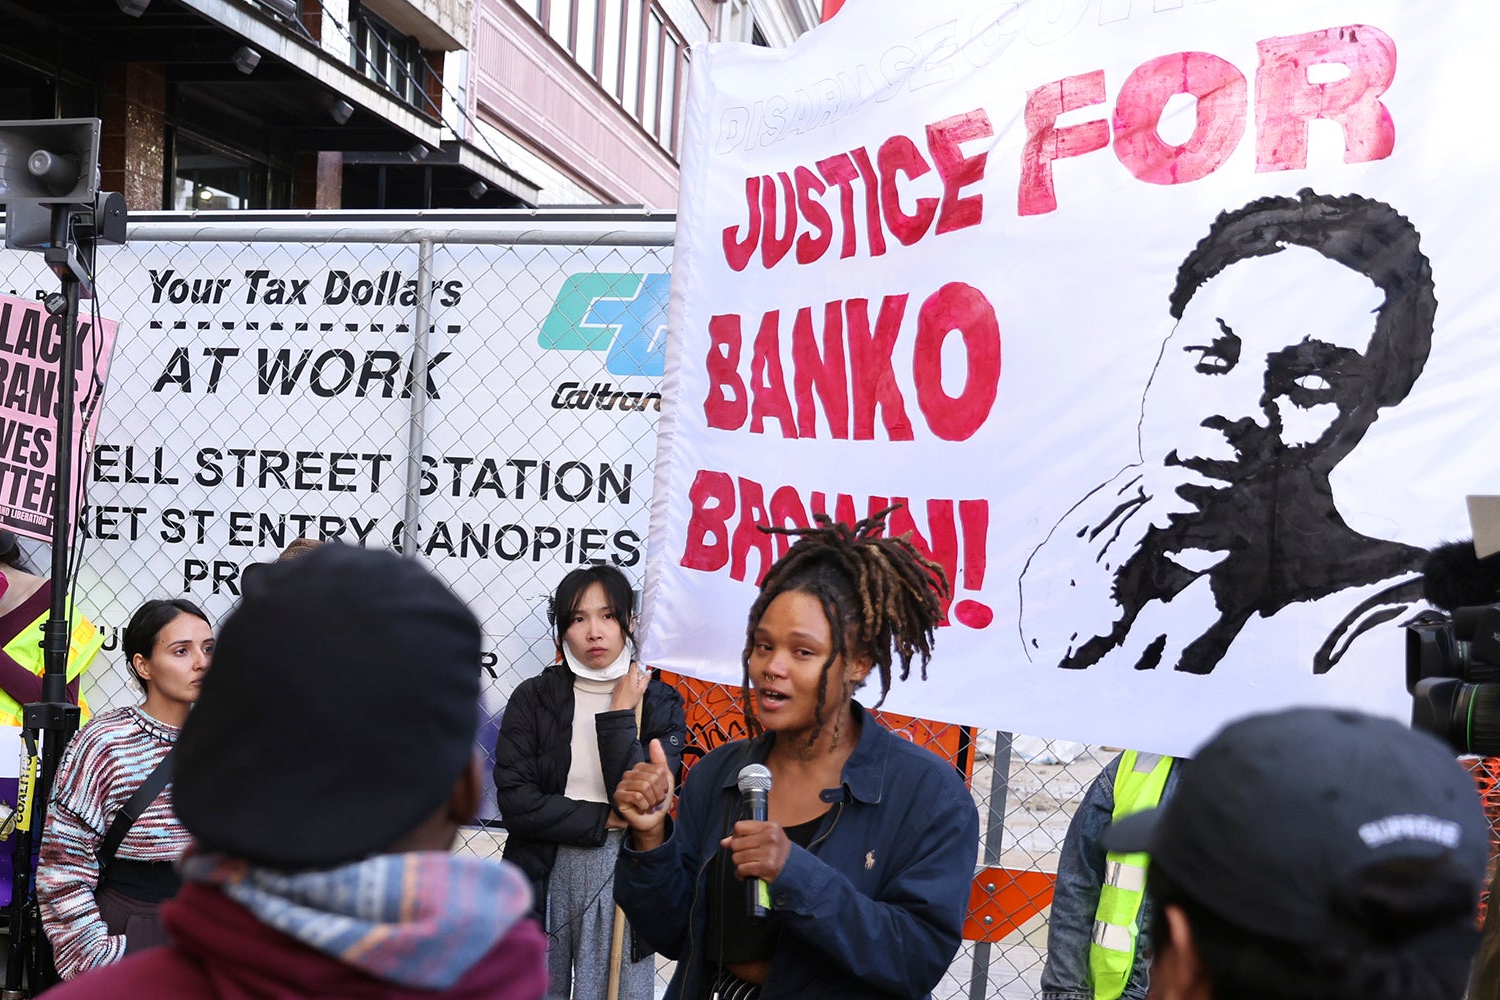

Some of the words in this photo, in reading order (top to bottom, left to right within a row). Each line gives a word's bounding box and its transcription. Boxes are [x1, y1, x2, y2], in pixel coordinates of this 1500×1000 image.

[1017, 24, 1396, 216] FOR
[722, 107, 995, 272] JUSTICE
[149, 269, 231, 306] Your
[242, 269, 308, 306] Tax
[324, 269, 463, 308] Dollars
[152, 347, 239, 394] AT
[257, 347, 451, 400] WORK
[703, 281, 1001, 442] BANKO
[551, 382, 661, 412] Caltran
[93, 445, 179, 486] ELL
[196, 445, 392, 495] STREET
[419, 453, 633, 506] STATION
[10, 508, 47, 527] LIBERATION
[160, 507, 214, 544] ST
[228, 512, 378, 552] ENTRY
[394, 520, 641, 568] CANOPIES
